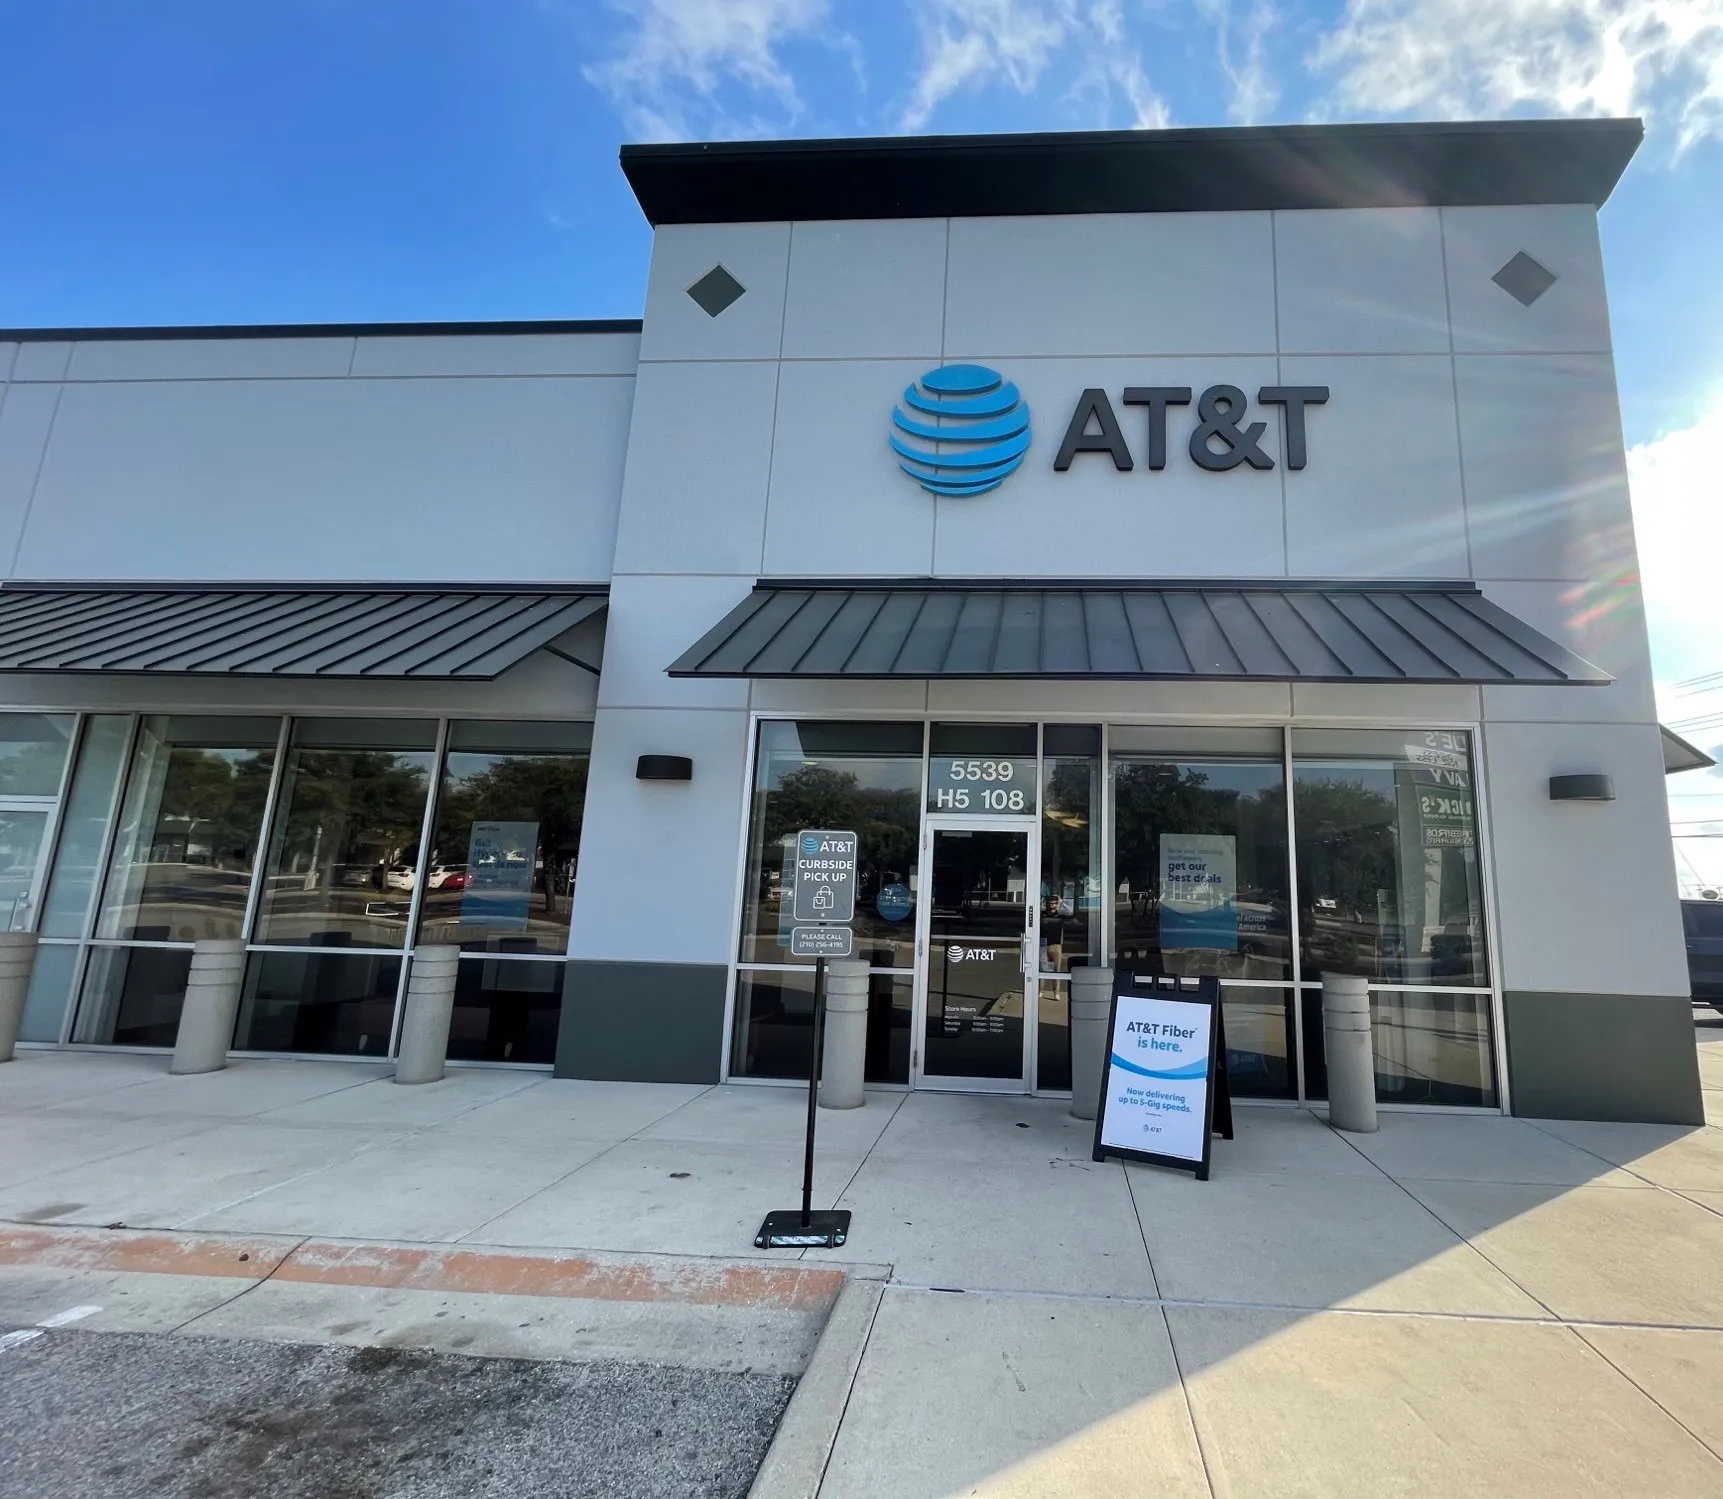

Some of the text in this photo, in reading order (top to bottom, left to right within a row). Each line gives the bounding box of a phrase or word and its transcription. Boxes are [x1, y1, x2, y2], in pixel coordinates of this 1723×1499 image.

[1053, 384, 1330, 471] AT&T
[949, 761, 1014, 781] 5539
[937, 788, 1025, 811] H5 108
[820, 841, 853, 852] AT&T
[799, 859, 853, 869] CURBSIDE
[1168, 863, 1186, 872] get
[804, 872, 847, 881] PICK UP
[1168, 873, 1222, 883] best deals
[1238, 923, 1267, 931] America
[966, 949, 996, 961] AT&T
[1126, 1021, 1196, 1039] AT&T Fiber
[1137, 1036, 1183, 1052] is here.
[1126, 1087, 1186, 1104] Now delivering
[1118, 1096, 1193, 1113] up to 5-Gig speeds.
